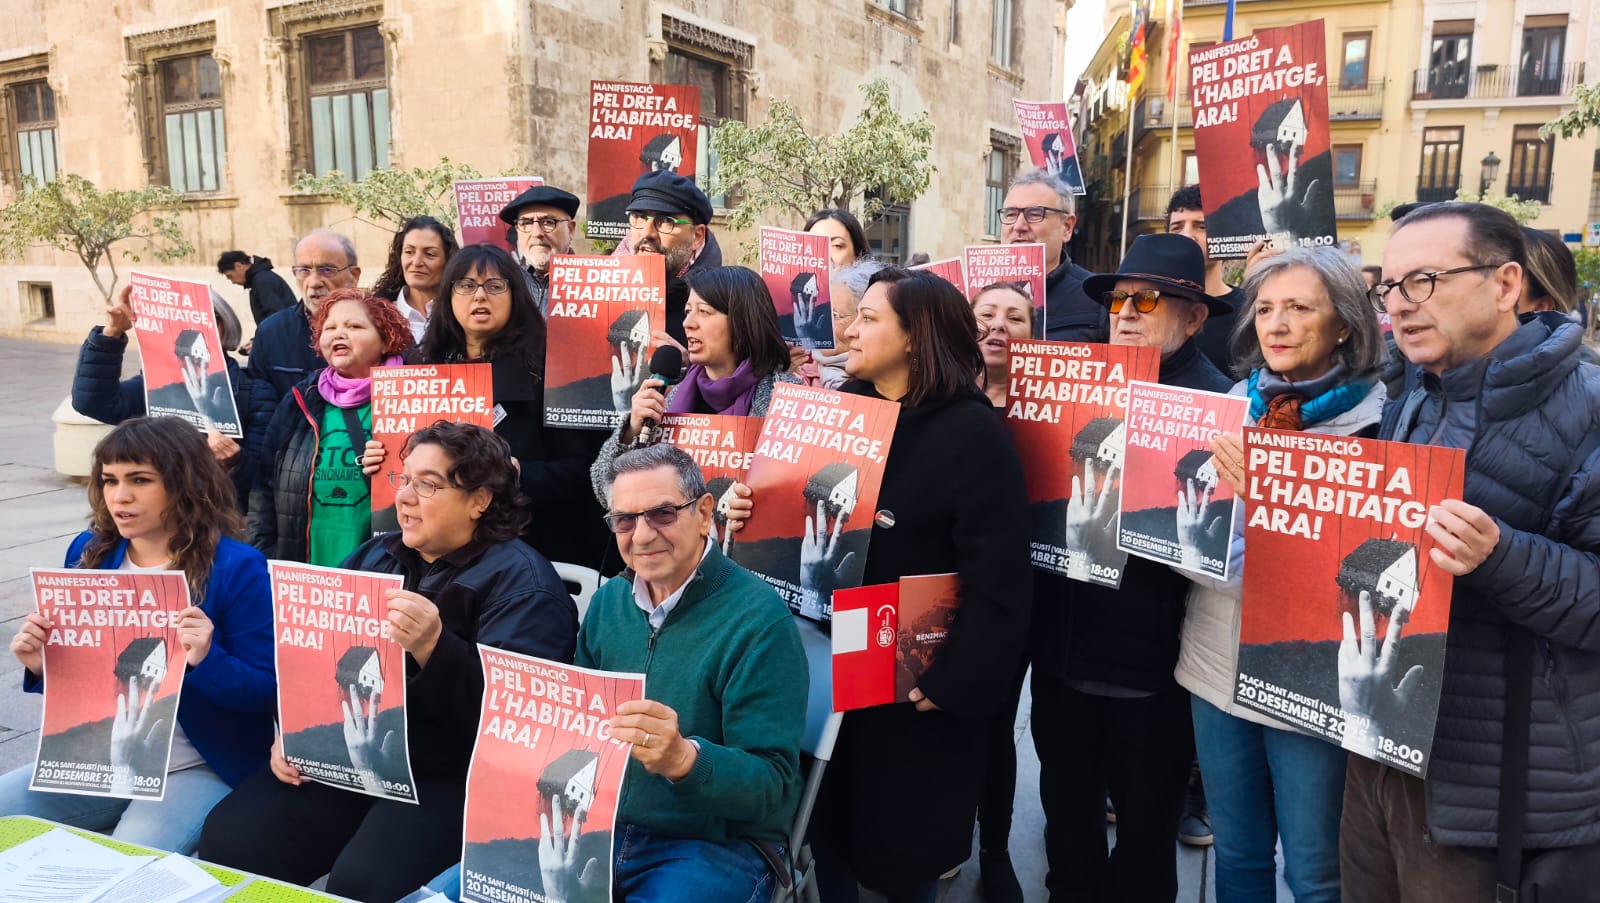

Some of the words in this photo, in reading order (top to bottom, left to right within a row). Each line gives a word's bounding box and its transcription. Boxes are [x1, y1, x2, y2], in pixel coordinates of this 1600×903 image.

[1191, 36, 1259, 64] MANIFESTACIÓ
[1193, 62, 1220, 86] PEL
[1224, 48, 1273, 78] DRET
[1275, 45, 1293, 66] A
[593, 83, 653, 94] MANIFESTACIÓ
[1194, 63, 1324, 107] L'HABITATGE,
[593, 92, 619, 107] PEL
[623, 94, 664, 110] DRET
[664, 97, 676, 111] A
[592, 108, 696, 131] L'HABITATGE,
[1195, 102, 1238, 129] ARA!
[591, 125, 632, 140] ARA!
[460, 192, 481, 202] PEL
[484, 191, 517, 202] DRET
[461, 204, 508, 215] L'HABI
[463, 217, 496, 227] ARA!
[763, 239, 777, 250] PEL
[779, 241, 803, 254] DRET
[804, 244, 812, 255] A
[1209, 244, 1219, 253] 20
[1299, 236, 1333, 248] 18:00
[553, 257, 620, 267] MANIFESTACIÓ
[763, 250, 827, 270] L'HABITATGE,
[763, 263, 784, 275] ARA!
[969, 256, 987, 266] PEL
[989, 255, 1016, 266] DRET
[1018, 255, 1027, 265] A
[553, 267, 582, 282] PEL
[587, 268, 630, 284] DRET
[632, 269, 644, 284] A
[970, 266, 1042, 277] L'HABITATGE,
[132, 286, 149, 299] PEL
[152, 288, 180, 305] DRET
[182, 294, 192, 307] A
[552, 284, 664, 304] L'HABITATGE,
[134, 301, 213, 329] L'HABITATGE,
[550, 302, 598, 318] ARA!
[135, 319, 164, 333] ARA!
[1010, 343, 1092, 357] MANIFESTACIÓ
[373, 366, 437, 378] MANIFESTACIÓ
[1010, 356, 1045, 376] PEL
[1050, 358, 1107, 380] DRET
[1107, 363, 1125, 383] A
[374, 380, 399, 396] PEL
[403, 379, 450, 395] DRET
[451, 378, 466, 394] A
[776, 387, 841, 405] MANIFESTACIÓ
[1010, 378, 1129, 408] L'HABITATG
[1134, 388, 1193, 404] MANIFESTACIÓ
[374, 397, 490, 416] L'HABITATGE,
[771, 398, 800, 418] PEL
[801, 404, 850, 428] DRET
[848, 413, 864, 433] A
[1008, 400, 1062, 424] ARA!
[1132, 398, 1157, 416] PEL
[1160, 402, 1203, 421] DRET
[1202, 410, 1216, 426] A
[374, 417, 416, 433] ARA!
[561, 414, 608, 424] DESEMBRE
[662, 416, 710, 426] ANIFESTACIÓ
[1130, 415, 1221, 443] L'HABITATG
[653, 426, 675, 443] PEL
[678, 428, 720, 447] DRET
[721, 431, 735, 448] A
[764, 418, 884, 464] L'HABITATGE,
[1128, 432, 1168, 451] ARA!
[1248, 432, 1363, 456] MANIFESTACIÓ
[315, 446, 357, 467] STO
[756, 440, 803, 464] ARA!
[1249, 448, 1297, 477] PEL
[1303, 454, 1384, 489] DRET
[1385, 467, 1412, 495] A
[1250, 476, 1440, 531] L'HABITATG
[1248, 506, 1323, 540] ARA!
[1031, 542, 1051, 551] GUSTÍ
[1121, 534, 1131, 543] 20
[1133, 537, 1172, 555] DESEMBRE
[1200, 555, 1224, 568] 18:00
[1031, 550, 1056, 564] MBRE
[1058, 556, 1085, 569] 205
[1091, 564, 1119, 579] 18:00
[38, 576, 119, 587] MANIFESTACIÓ
[276, 570, 342, 588] MANIFESTACIÓ
[41, 588, 76, 606] PEL
[80, 590, 135, 607] DRET
[139, 590, 157, 607] A
[278, 582, 307, 604] PEL
[310, 587, 354, 611] DRET
[356, 594, 370, 614] A
[44, 608, 180, 628] L'HABITATGE
[47, 629, 102, 647] ARA!
[280, 627, 324, 651] ARA!
[916, 632, 947, 640] BENIMAC
[487, 654, 568, 682] MANIFESTACIÓ
[491, 667, 526, 693] PEL
[530, 677, 584, 708] DRET
[588, 694, 606, 714] A
[1240, 673, 1264, 689] PLAÇA
[1265, 683, 1288, 697] SANT
[1287, 692, 1319, 709] AGUSTÍ
[489, 689, 627, 750] L'HABITATG,
[1238, 683, 1256, 699] 20
[1258, 690, 1327, 727] DESEMBRE
[1328, 718, 1367, 740] 205
[1378, 736, 1423, 764] 18:00
[484, 716, 541, 749] ARA!
[40, 760, 59, 769] PLAÇA
[305, 758, 320, 767] SANT
[38, 768, 52, 778] 20
[53, 769, 101, 782] DESEMBRE
[134, 776, 160, 787] 18:00
[303, 766, 350, 782] DESEMBRE
[382, 780, 410, 793] 18:00
[466, 879, 480, 892] 20
[467, 870, 487, 883] PLAÇA
[488, 876, 505, 889] SANT
[505, 883, 530, 897] AGUSTÍ
